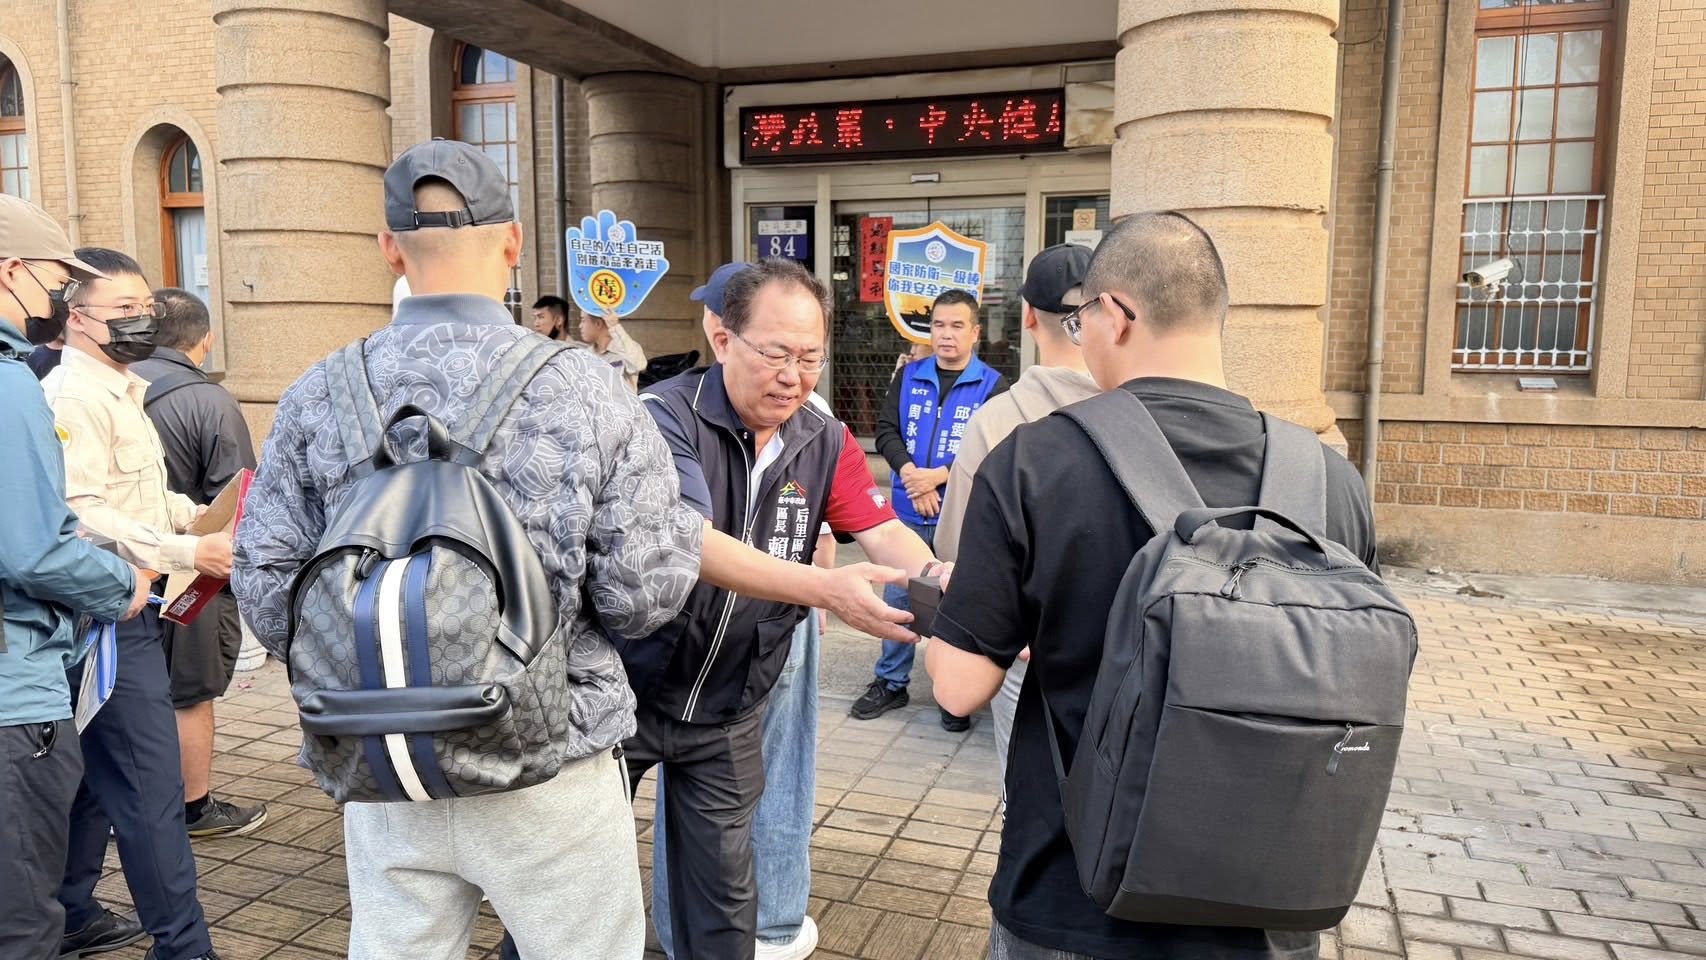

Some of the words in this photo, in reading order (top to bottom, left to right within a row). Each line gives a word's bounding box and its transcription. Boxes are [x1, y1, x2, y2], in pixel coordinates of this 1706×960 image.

[572, 239, 661, 256] 自己的人生自己活
[770, 236, 795, 257] 84
[577, 254, 657, 269] 別被毒品牽著走
[889, 261, 980, 286] 國家防衛一級棒
[888, 278, 978, 298] 你我安全
[774, 507, 789, 533] 區長
